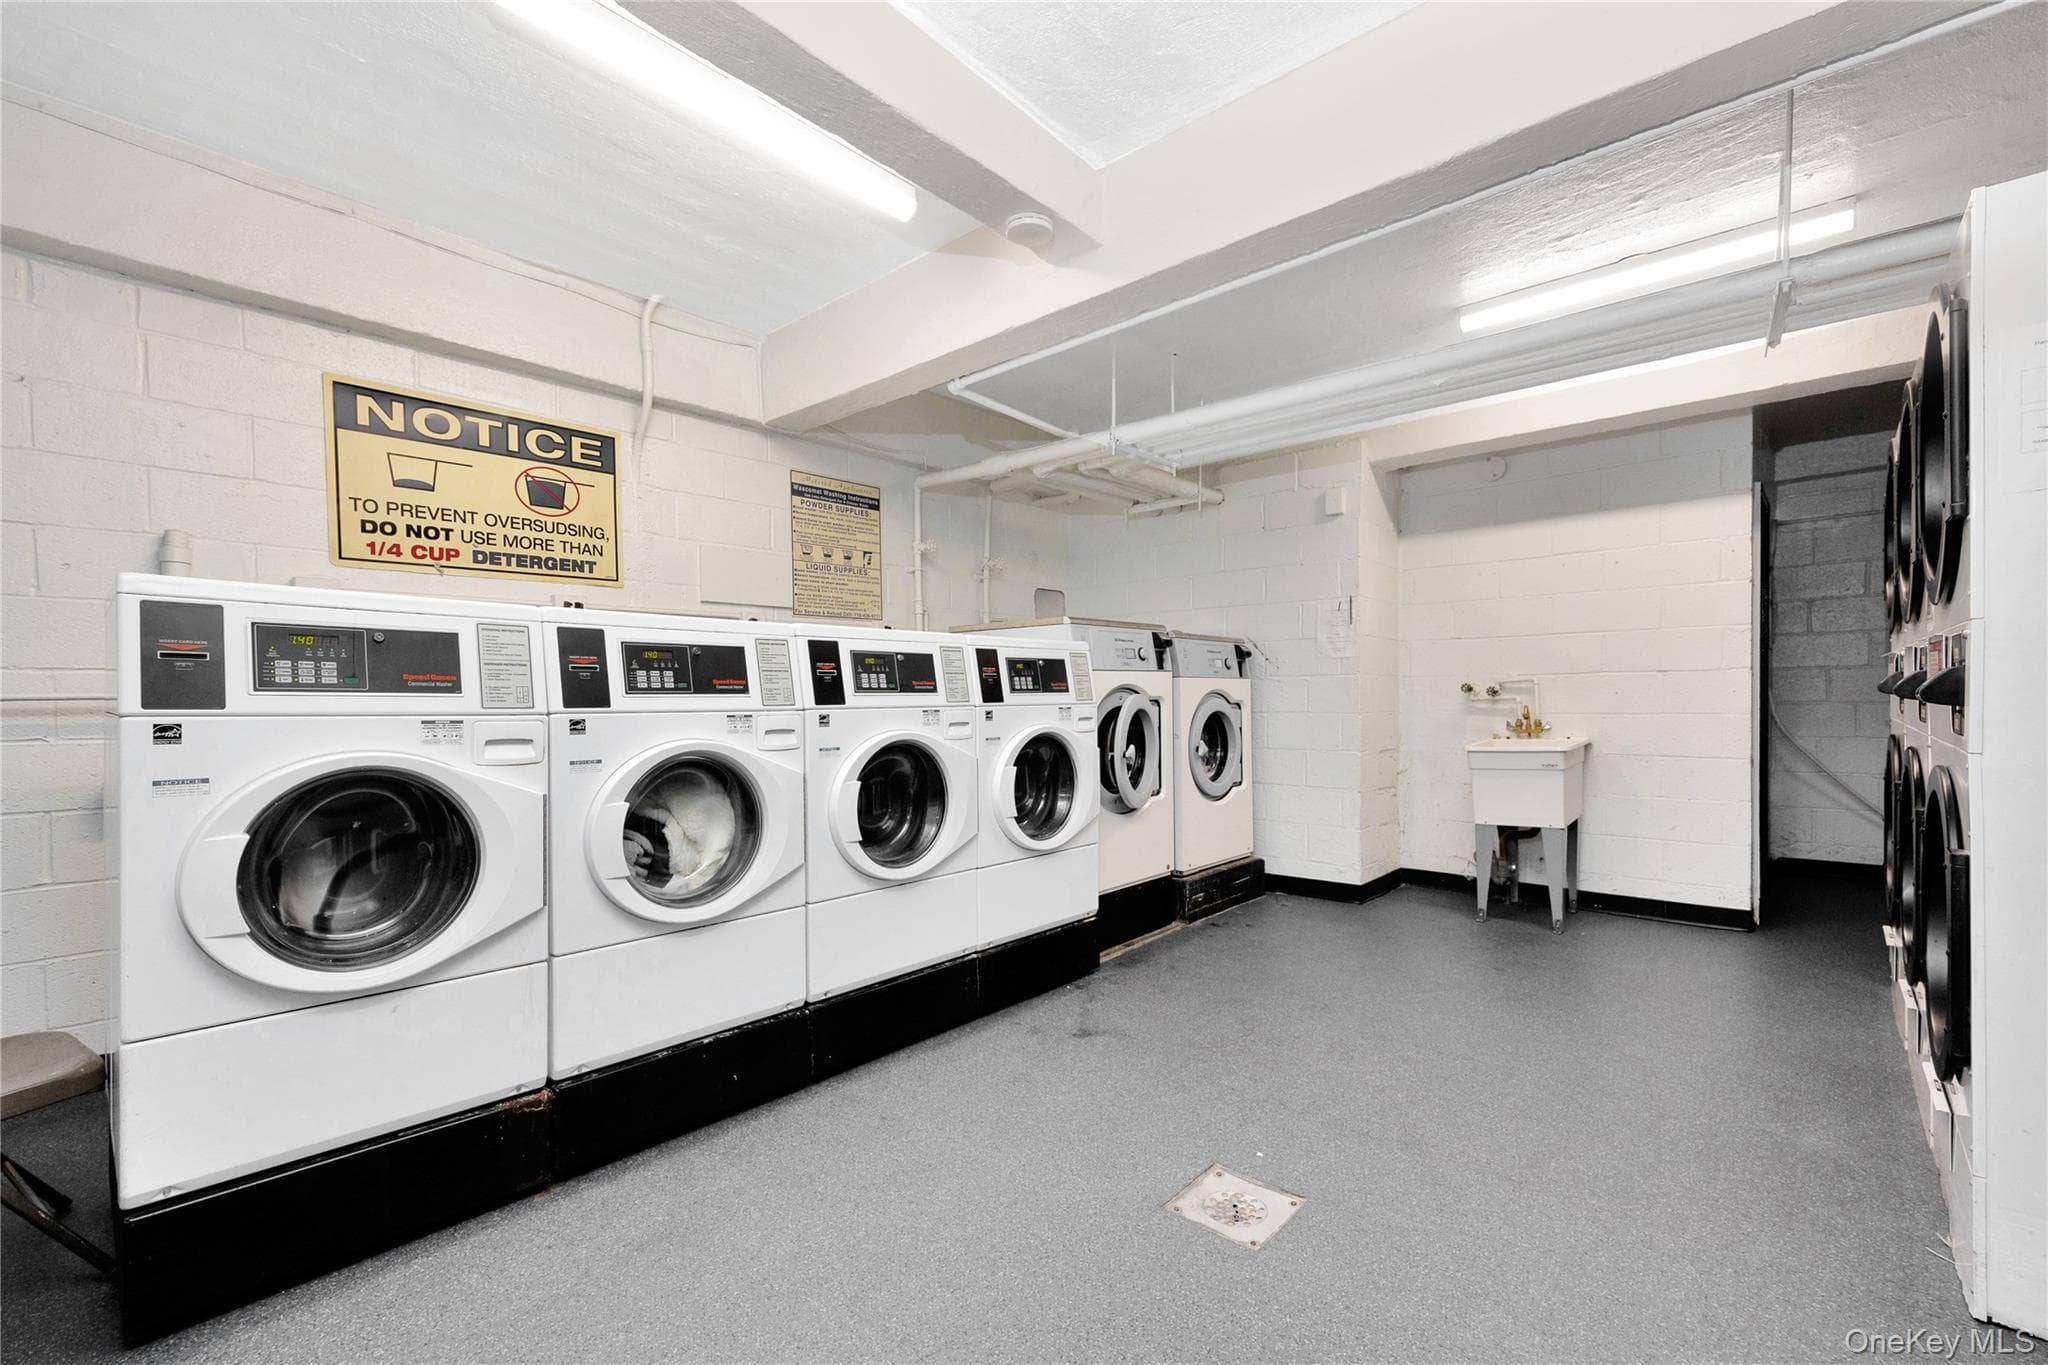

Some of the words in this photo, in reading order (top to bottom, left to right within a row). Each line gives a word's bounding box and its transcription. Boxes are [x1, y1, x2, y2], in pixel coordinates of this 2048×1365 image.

[356, 394, 602, 467] NOTICE
[792, 484, 822, 494] Wascomat
[823, 490, 846, 500] Washing
[848, 494, 878, 505] Instructions
[800, 499, 833, 510] POWDER
[835, 504, 872, 518] SUPPLIES:
[348, 496, 378, 514] TO
[386, 501, 478, 525] PREVENT
[484, 513, 610, 542] OVERSUDSING,
[360, 518, 398, 536] DO
[406, 524, 454, 542] NOT
[460, 530, 497, 546] USE
[503, 534, 554, 552] MORE
[560, 540, 604, 557] THAN
[366, 540, 403, 558] 1/4
[410, 544, 460, 562] CUP
[472, 550, 597, 574] DETERGENT
[806, 563, 832, 572] LIQUID
